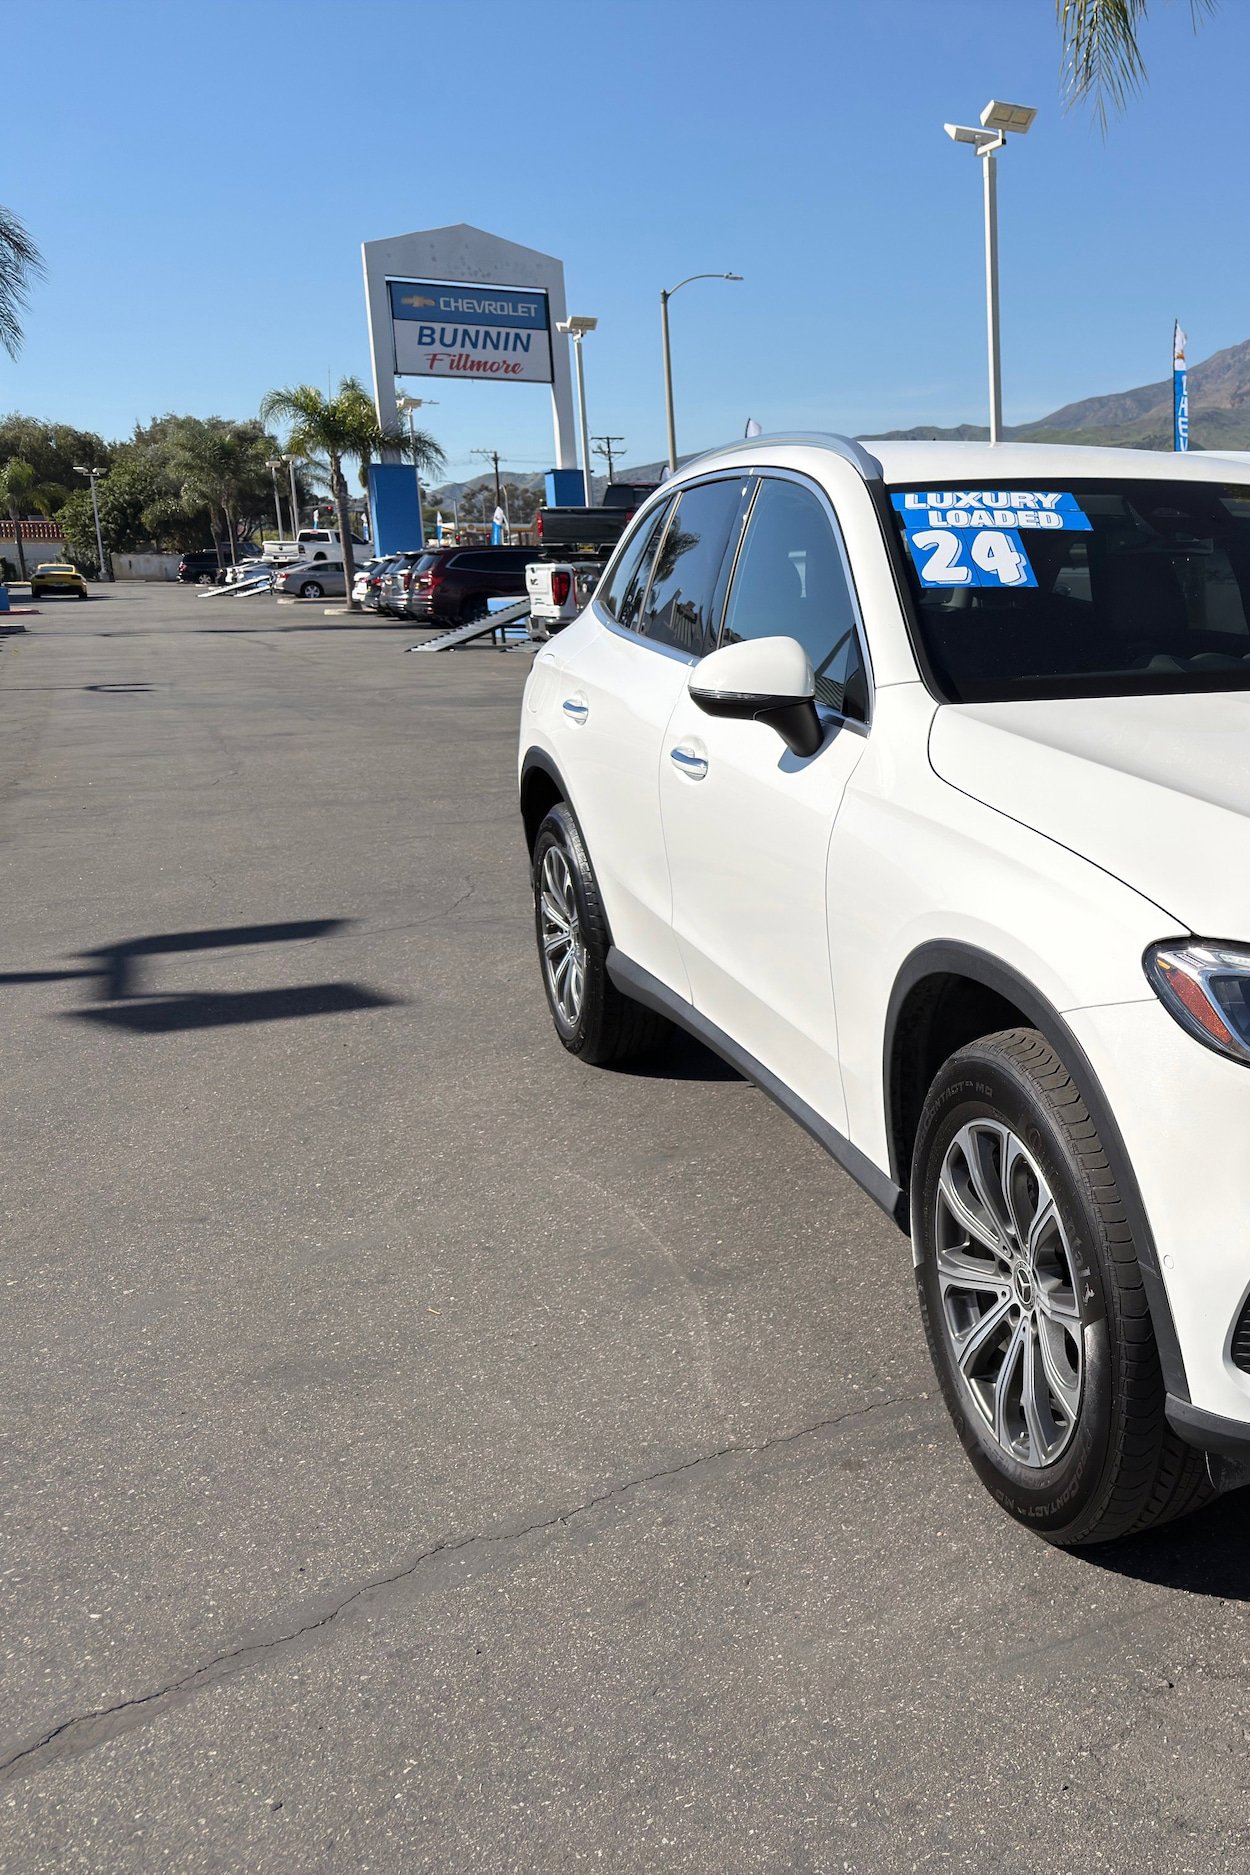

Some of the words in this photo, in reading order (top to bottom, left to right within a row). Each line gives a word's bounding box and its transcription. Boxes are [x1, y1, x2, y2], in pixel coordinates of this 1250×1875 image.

[440, 297, 538, 317] CHEVROLET
[417, 326, 532, 353] BUNNIN
[424, 353, 524, 375] Fillmore
[904, 492, 1063, 510] LUXURY
[929, 511, 1064, 529] LOADED
[911, 530, 1027, 587] 24
